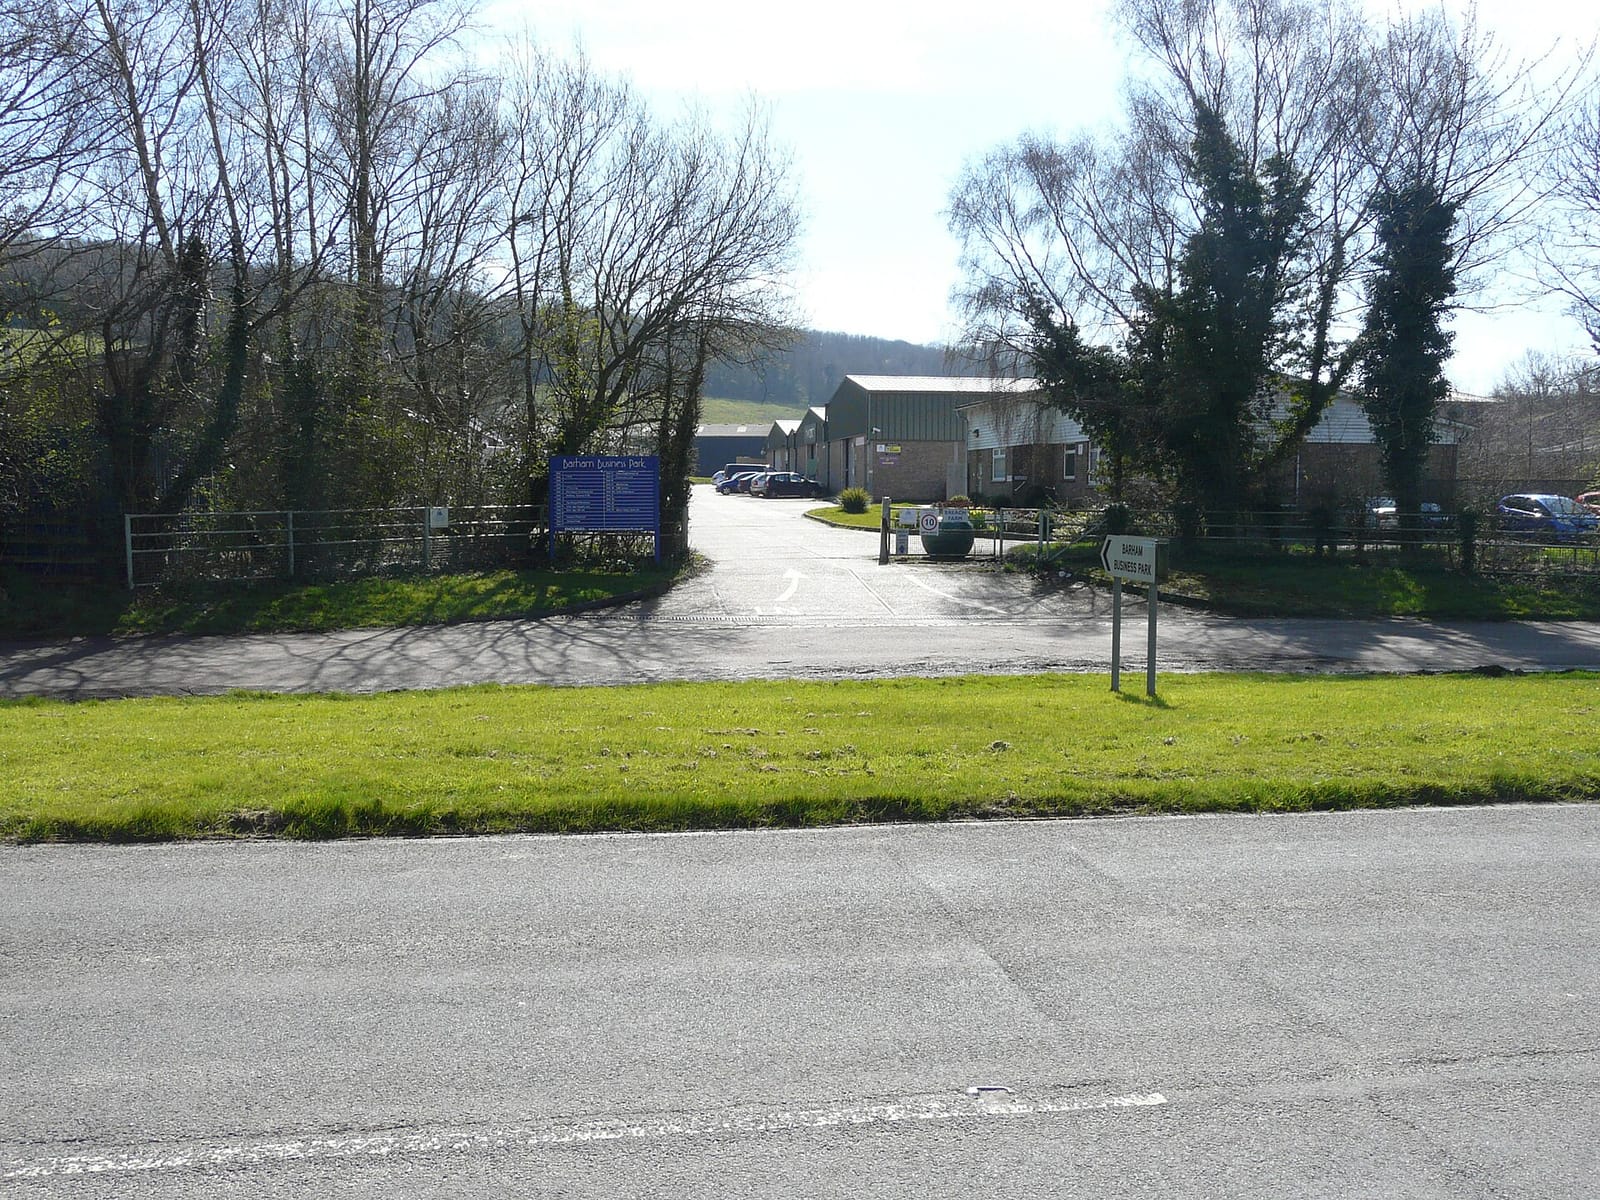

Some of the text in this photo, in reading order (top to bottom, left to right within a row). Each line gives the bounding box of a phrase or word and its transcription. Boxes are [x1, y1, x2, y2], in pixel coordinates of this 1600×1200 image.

[562, 458, 595, 470] Barham
[629, 458, 647, 469] Park
[925, 518, 935, 526] 10
[1122, 543, 1143, 556] BARHAM
[1113, 559, 1152, 576] BUSINESS PARK
